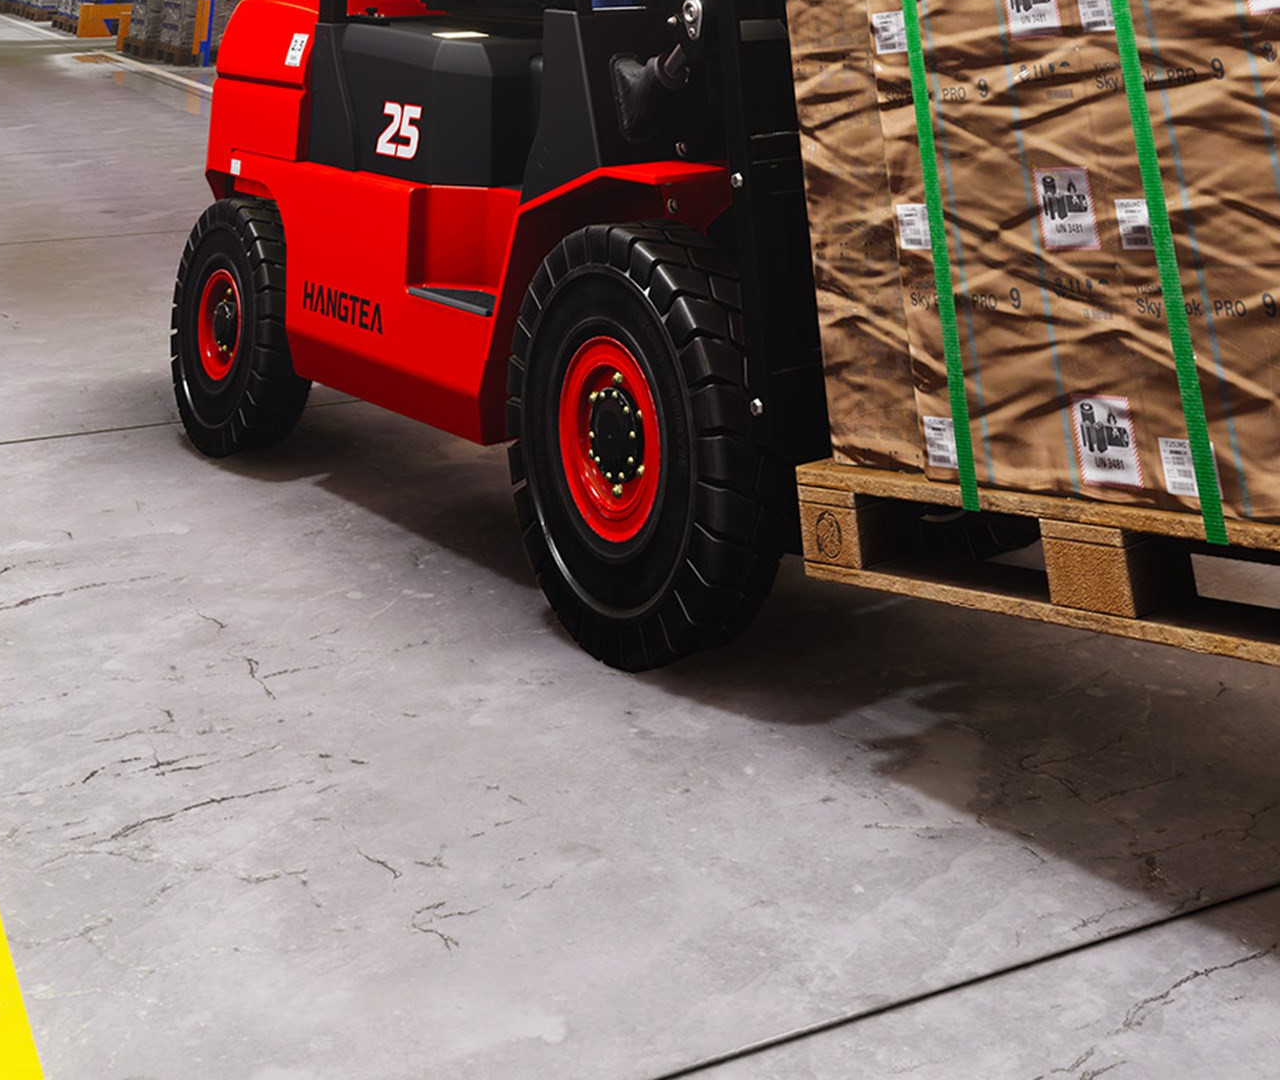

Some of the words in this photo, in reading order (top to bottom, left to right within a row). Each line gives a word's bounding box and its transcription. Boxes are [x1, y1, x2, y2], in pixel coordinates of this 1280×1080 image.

[1095, 74, 1119, 92] Sky
[1167, 67, 1198, 84] PRO
[1210, 58, 1225, 80] 9
[942, 86, 967, 102] PRO
[977, 78, 989, 98] 9
[375, 100, 423, 161] 25
[302, 280, 383, 335] HANGTEA
[910, 292, 930, 311] Sky
[972, 294, 998, 310] PRO
[1009, 287, 1021, 309] 9
[1136, 298, 1162, 319] Sky
[1213, 298, 1247, 318] PRO
[1261, 292, 1277, 318] 9
[1094, 456, 1107, 469] UN
[1107, 457, 1125, 471] 3481
